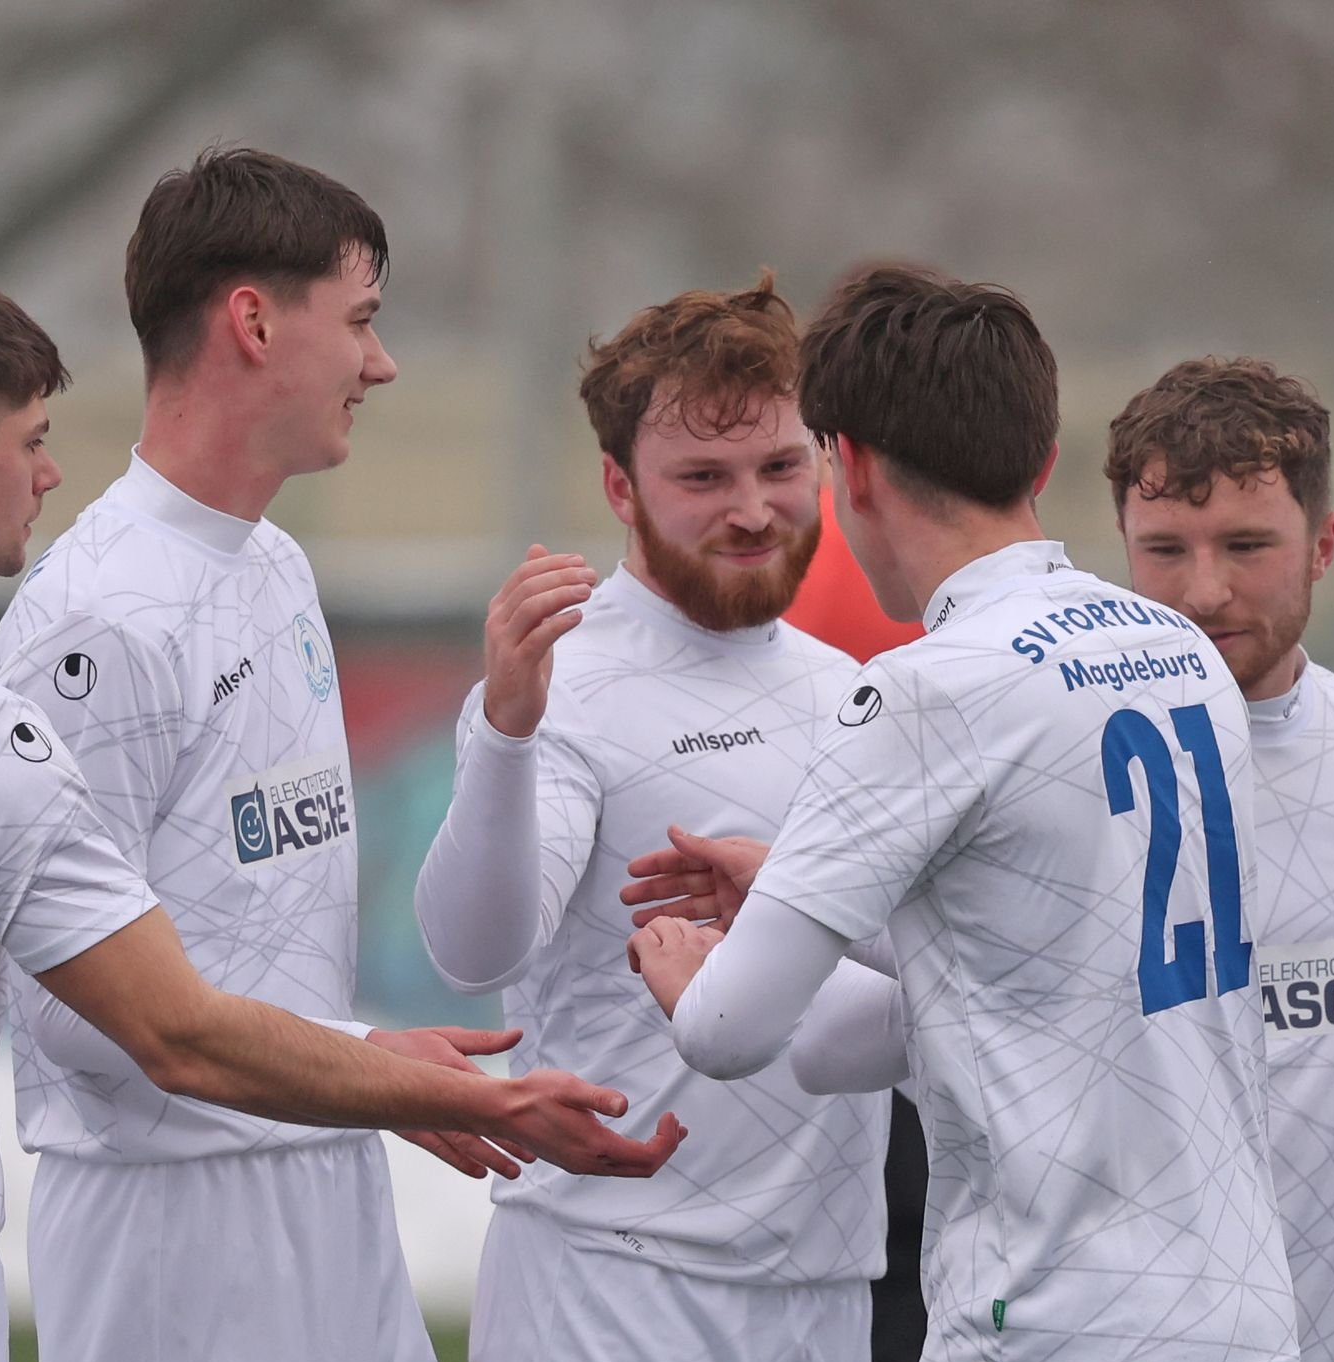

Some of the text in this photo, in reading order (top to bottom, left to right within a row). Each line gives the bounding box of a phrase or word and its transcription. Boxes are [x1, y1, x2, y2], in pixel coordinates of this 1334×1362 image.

[1012, 600, 1201, 665] SV FORTUNA
[1059, 650, 1208, 692] Magdeburg
[672, 726, 766, 755] uhlsport
[273, 785, 351, 856] ASCHE
[1101, 703, 1254, 1017] 21
